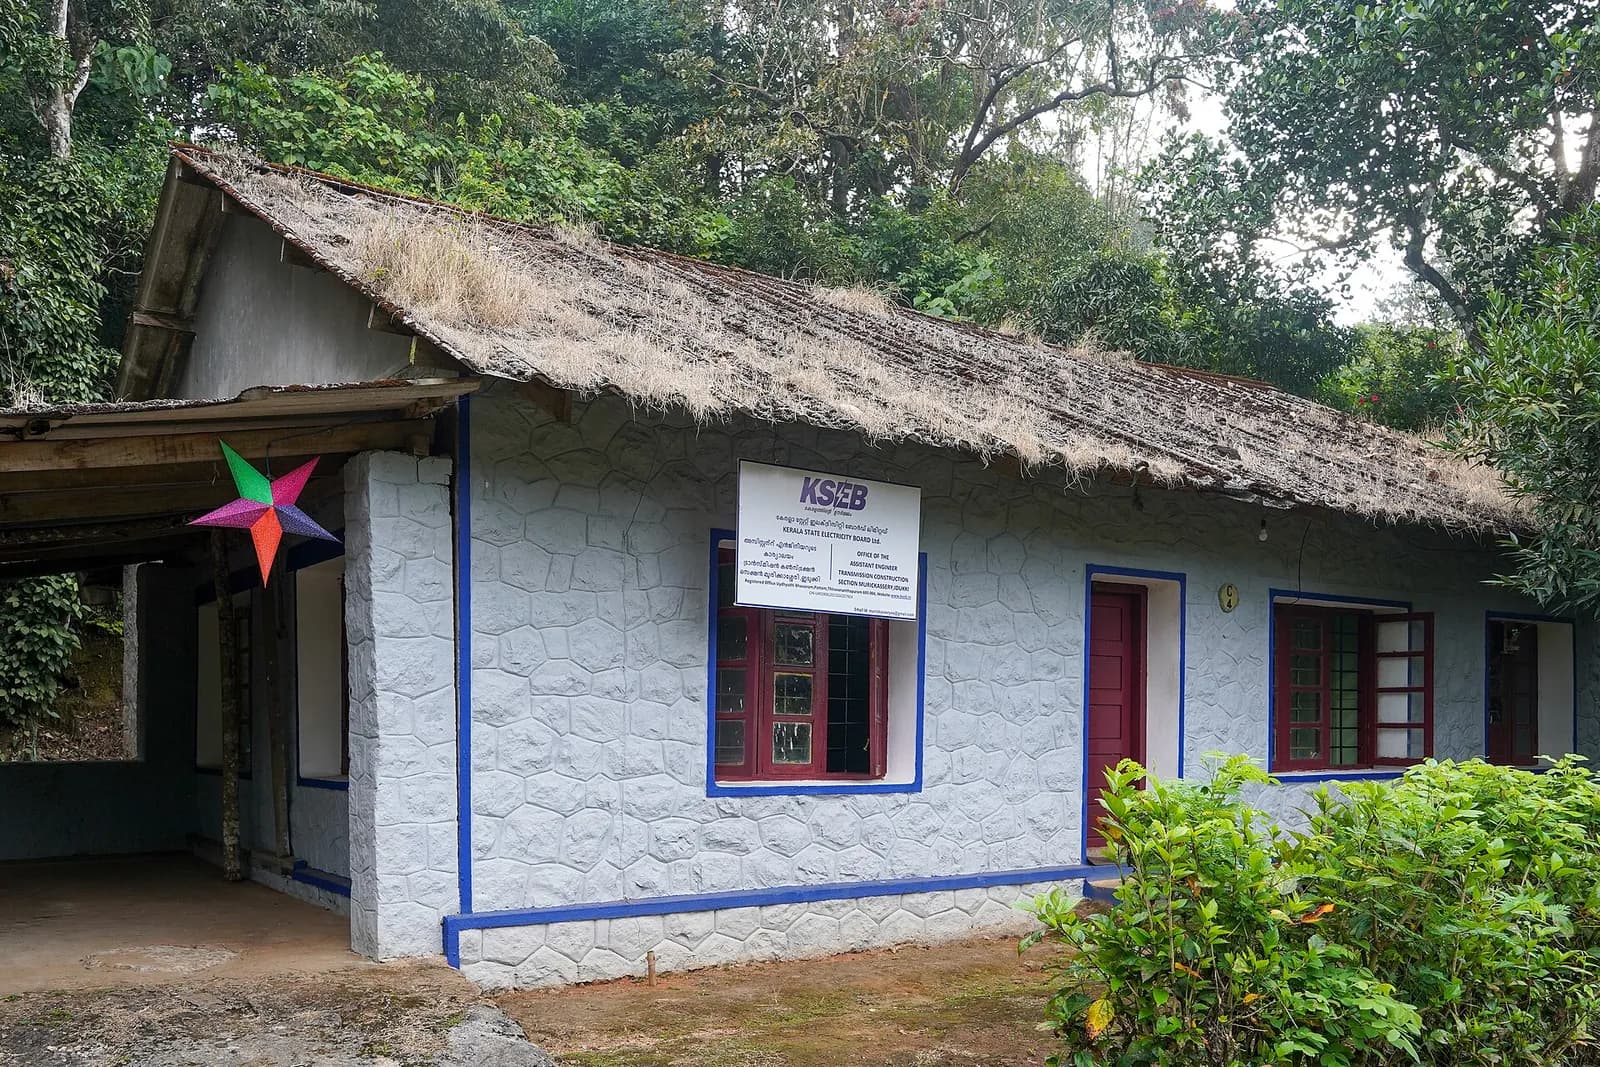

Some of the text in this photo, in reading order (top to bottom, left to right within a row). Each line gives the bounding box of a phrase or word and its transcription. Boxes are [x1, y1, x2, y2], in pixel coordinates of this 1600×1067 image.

[800, 477, 868, 511] KSEB
[782, 526, 804, 535] KERALA
[804, 529, 820, 537] STATE
[821, 531, 852, 541] ELECTRICITY
[852, 534, 871, 543] BOARD
[856, 550, 873, 559] OFFICE
[849, 560, 898, 571] ASSISTANT ENGINEER
[838, 569, 909, 583] TRANSMISSION CONSTRUCTION
[838, 578, 858, 586] SECTION
